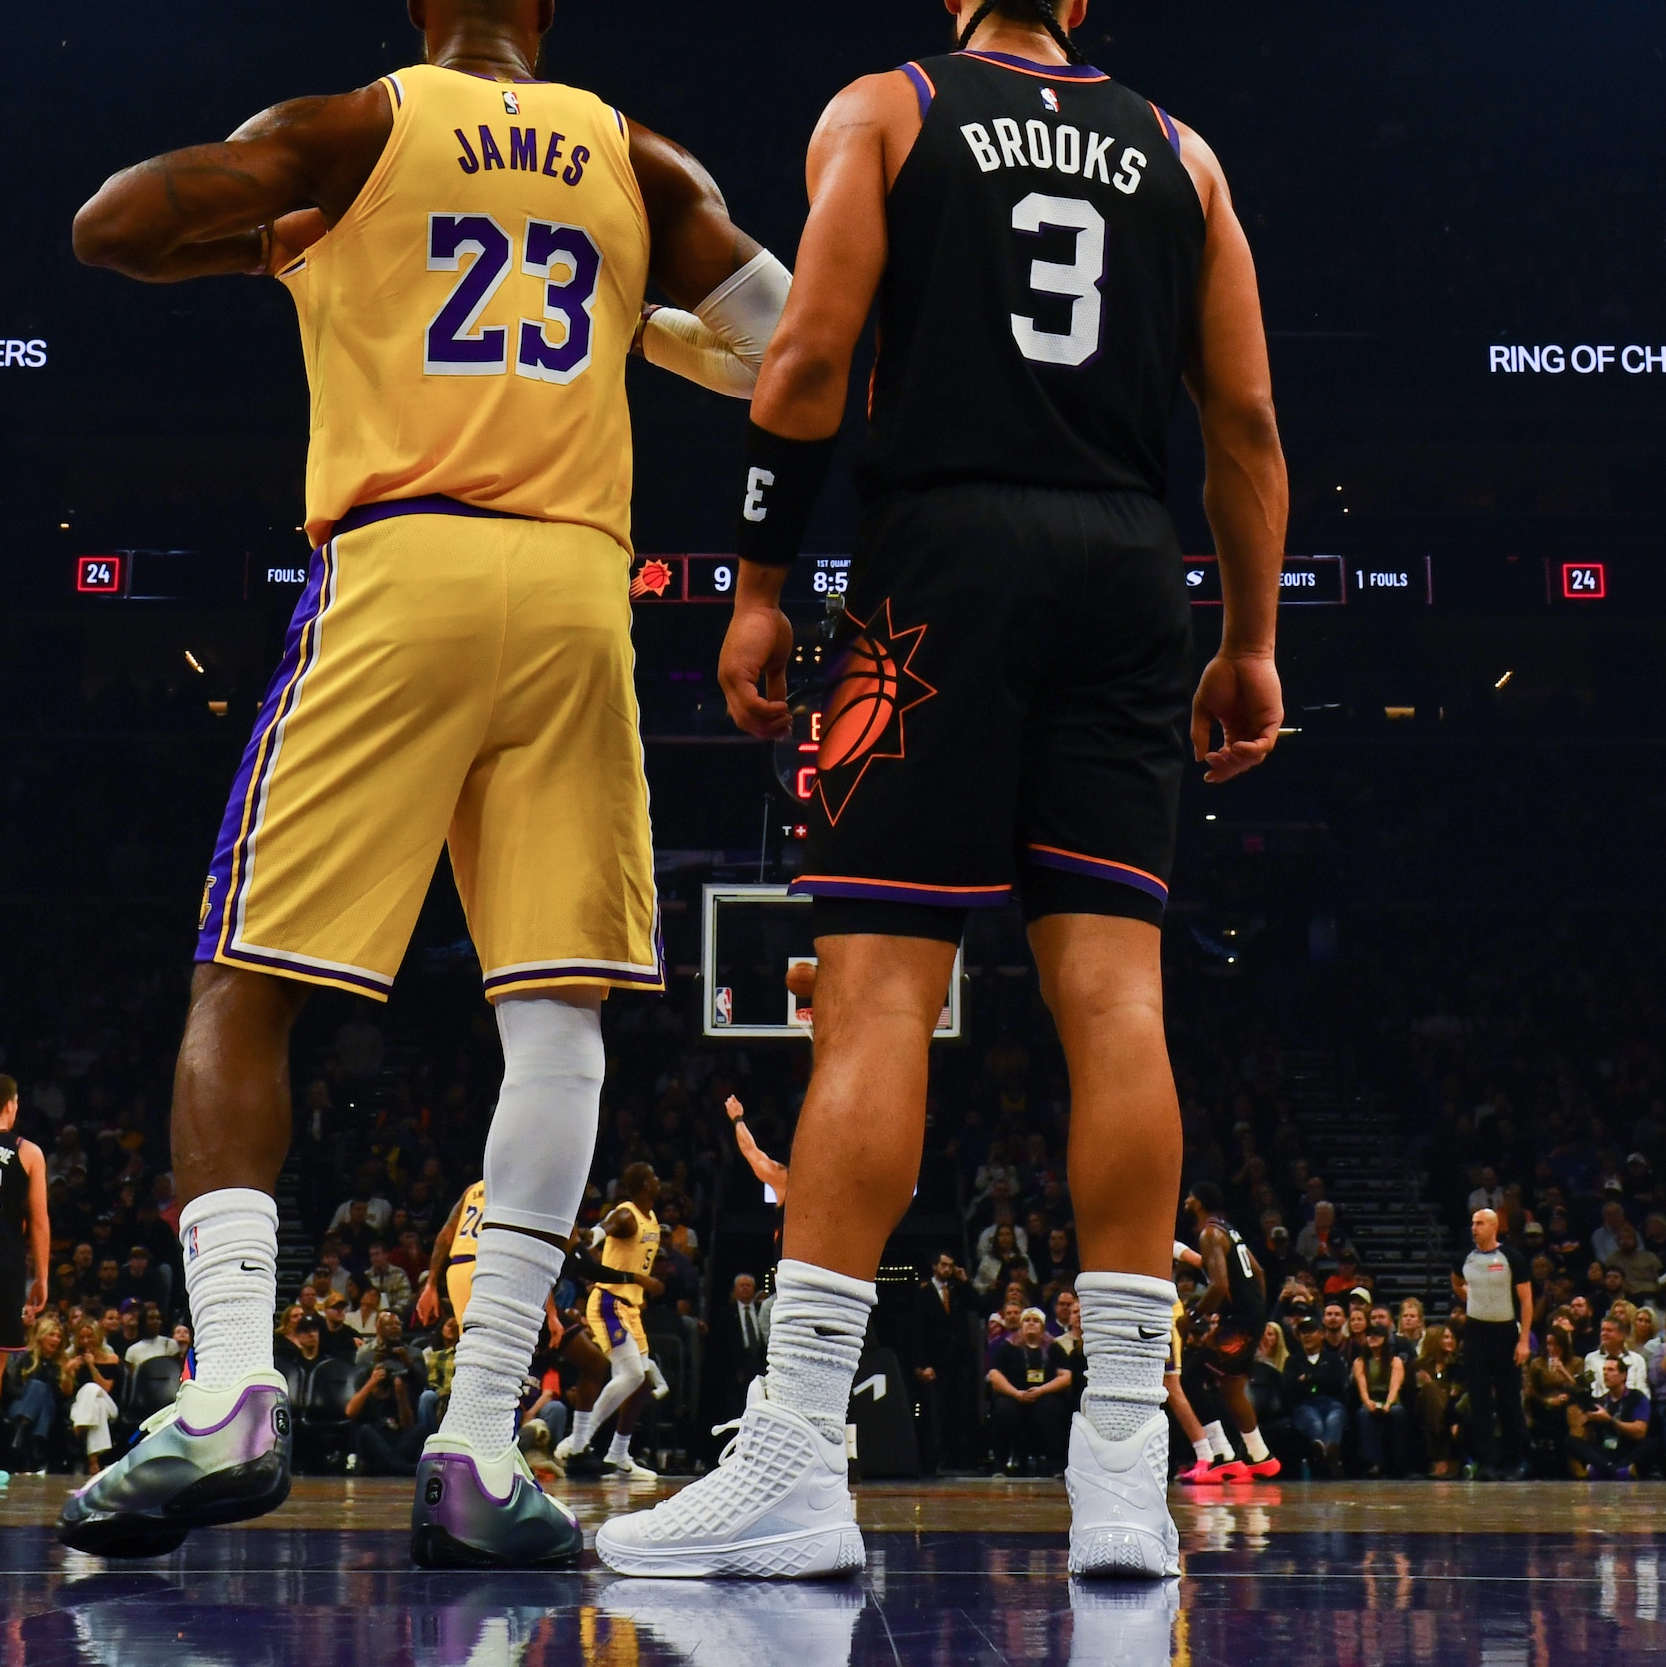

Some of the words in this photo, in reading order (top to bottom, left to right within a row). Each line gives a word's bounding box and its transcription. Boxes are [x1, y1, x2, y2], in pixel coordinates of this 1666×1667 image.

[453, 124, 591, 187] JAMES
[959, 117, 1148, 195] BROOKS
[1010, 191, 1106, 367] 3
[423, 211, 604, 386] 23
[1490, 345, 1565, 373] RING
[1571, 345, 1615, 373] OF
[86, 563, 111, 584] 24
[268, 569, 305, 582] FOULS
[714, 566, 731, 591] 9
[1277, 570, 1315, 589] EOUTS
[1356, 570, 1363, 589] 1
[1370, 573, 1407, 586] FOULS
[1571, 569, 1596, 591] 24
